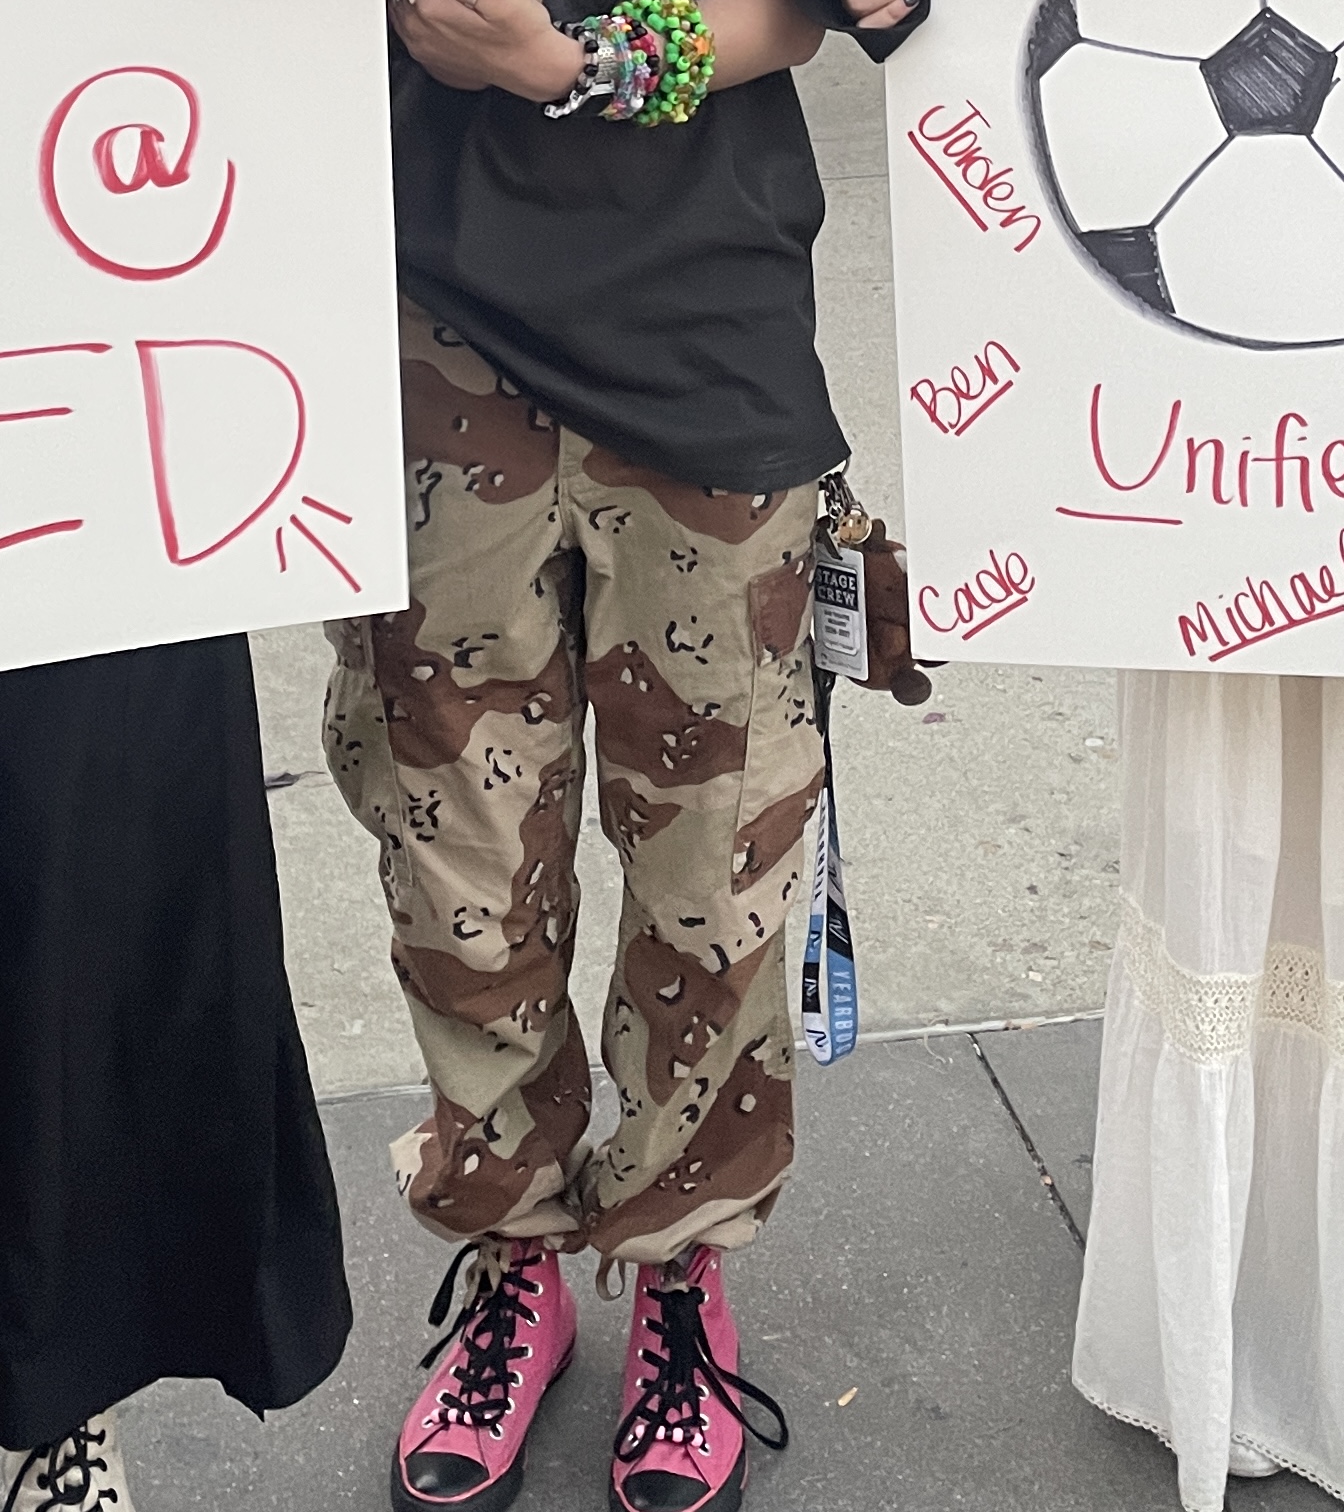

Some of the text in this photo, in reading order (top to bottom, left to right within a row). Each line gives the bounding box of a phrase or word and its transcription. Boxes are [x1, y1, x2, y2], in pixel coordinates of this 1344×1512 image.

[40, 66, 236, 281] @
[910, 340, 1020, 436] Ben
[815, 569, 856, 590] STAGE
[817, 585, 856, 607] CREW
[918, 548, 1035, 633] Cade
